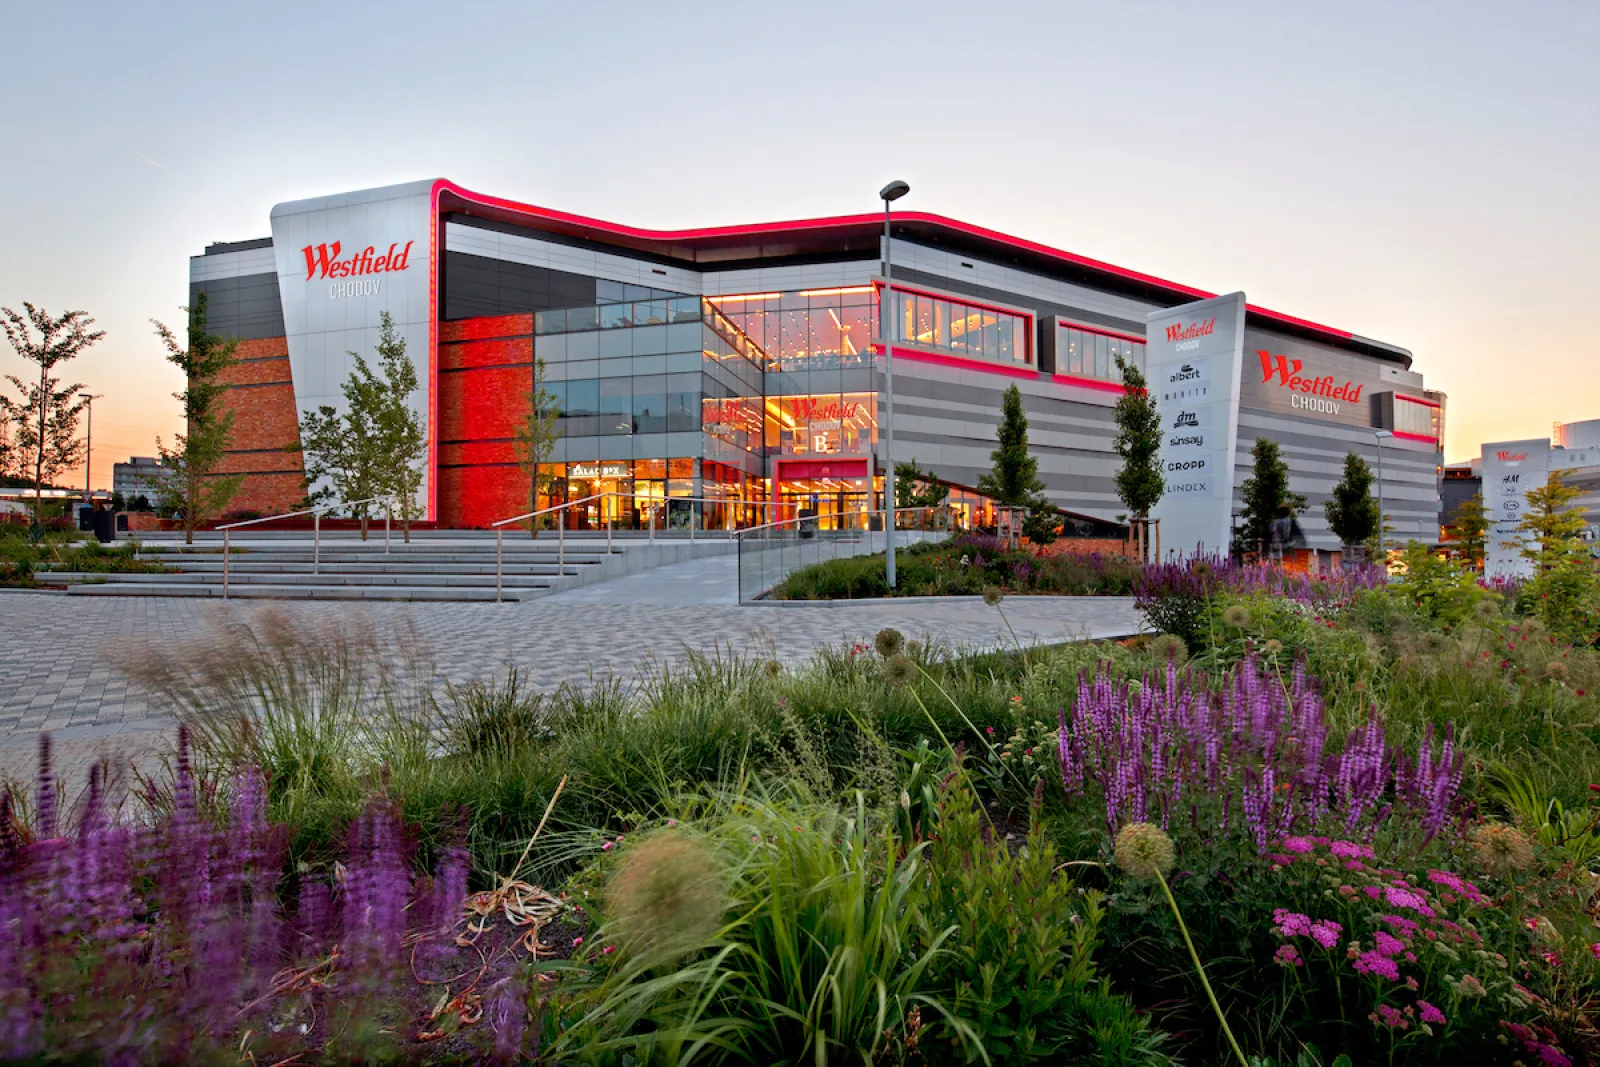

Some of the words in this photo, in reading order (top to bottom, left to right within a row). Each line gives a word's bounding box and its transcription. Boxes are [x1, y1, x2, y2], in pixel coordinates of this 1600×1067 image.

[300, 240, 415, 281] Westfield
[330, 279, 381, 299] CHODOV
[1165, 316, 1216, 343] Westfield
[1170, 369, 1200, 383] albert
[1253, 350, 1364, 403] Westfield
[791, 397, 858, 420] Westfield
[1291, 394, 1340, 415] CHODOV
[1175, 410, 1198, 425] dm
[813, 435, 828, 453] B
[1170, 435, 1204, 446] sinsay
[1167, 460, 1206, 472] CROPP
[1167, 482, 1207, 493] LINDEX
